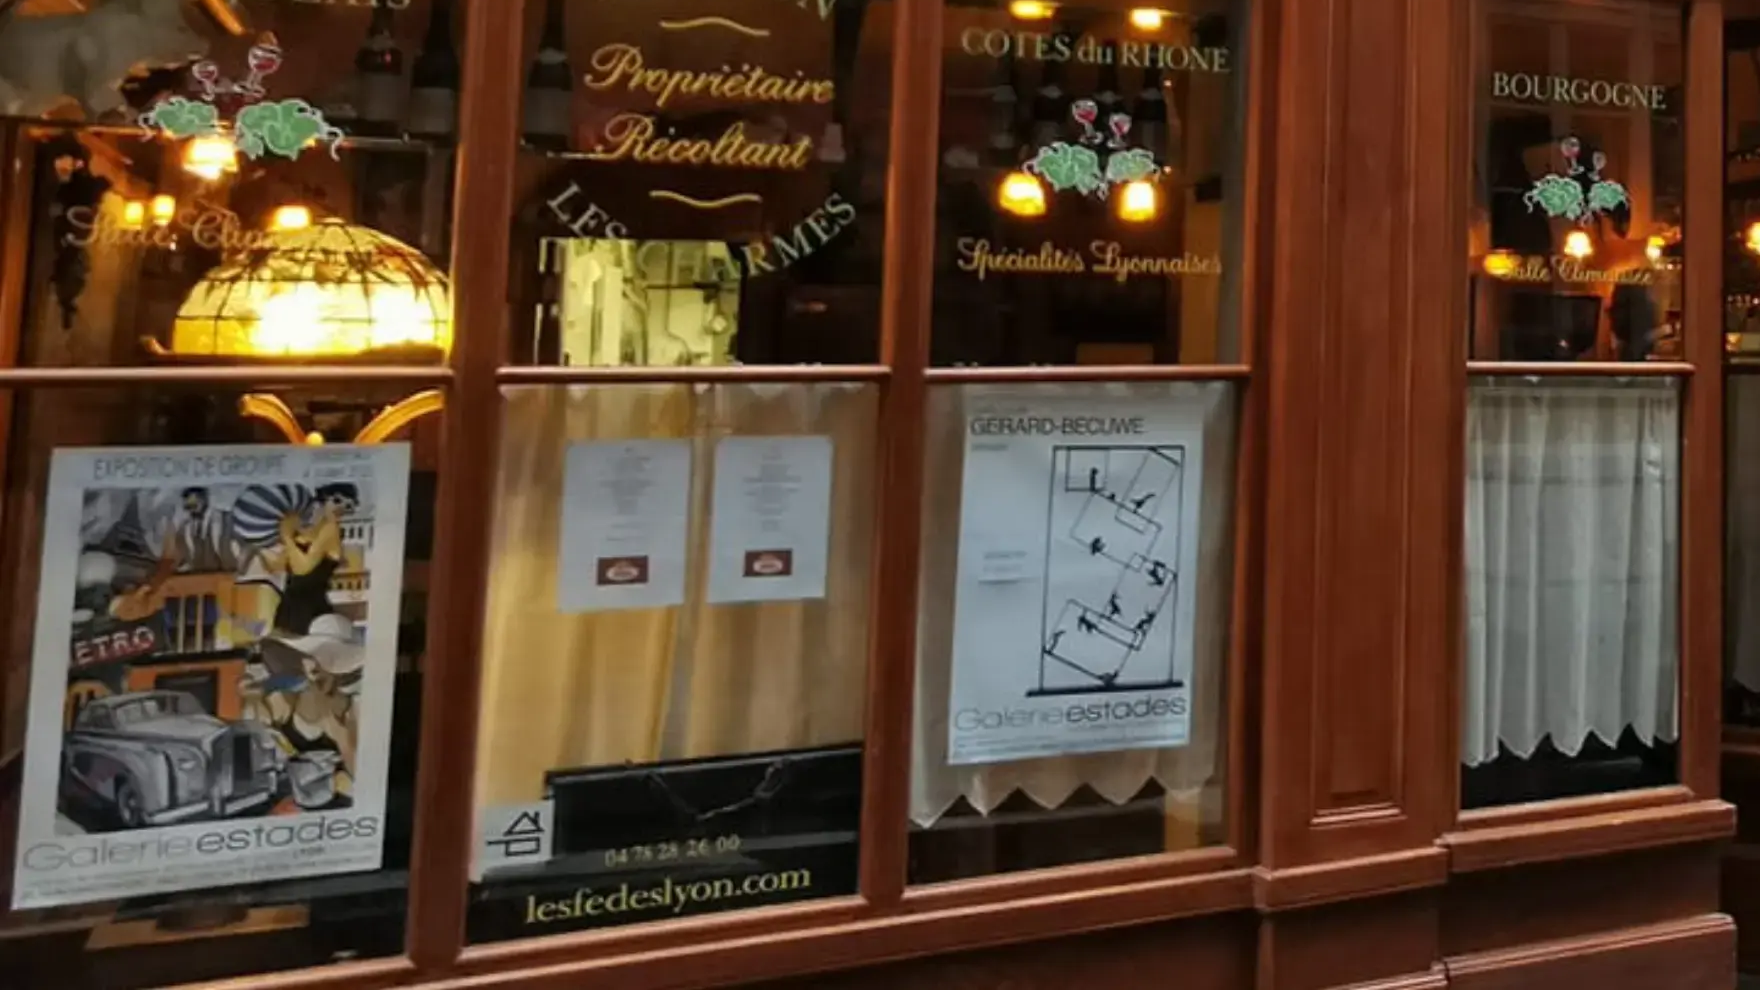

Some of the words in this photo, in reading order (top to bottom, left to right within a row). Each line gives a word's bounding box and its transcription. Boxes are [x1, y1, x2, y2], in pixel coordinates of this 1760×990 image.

[1077, 33, 1113, 65] du
[583, 43, 836, 107] Propriétaire
[1493, 71, 1668, 110] BOURGOGNE
[594, 113, 812, 169] Récoltant
[546, 180, 629, 243] LES
[634, 192, 857, 283] CHARMES
[1089, 239, 1223, 282] Lyonnaises
[715, 834, 742, 853] 00
[525, 867, 811, 924] lesfedeslyon.com
